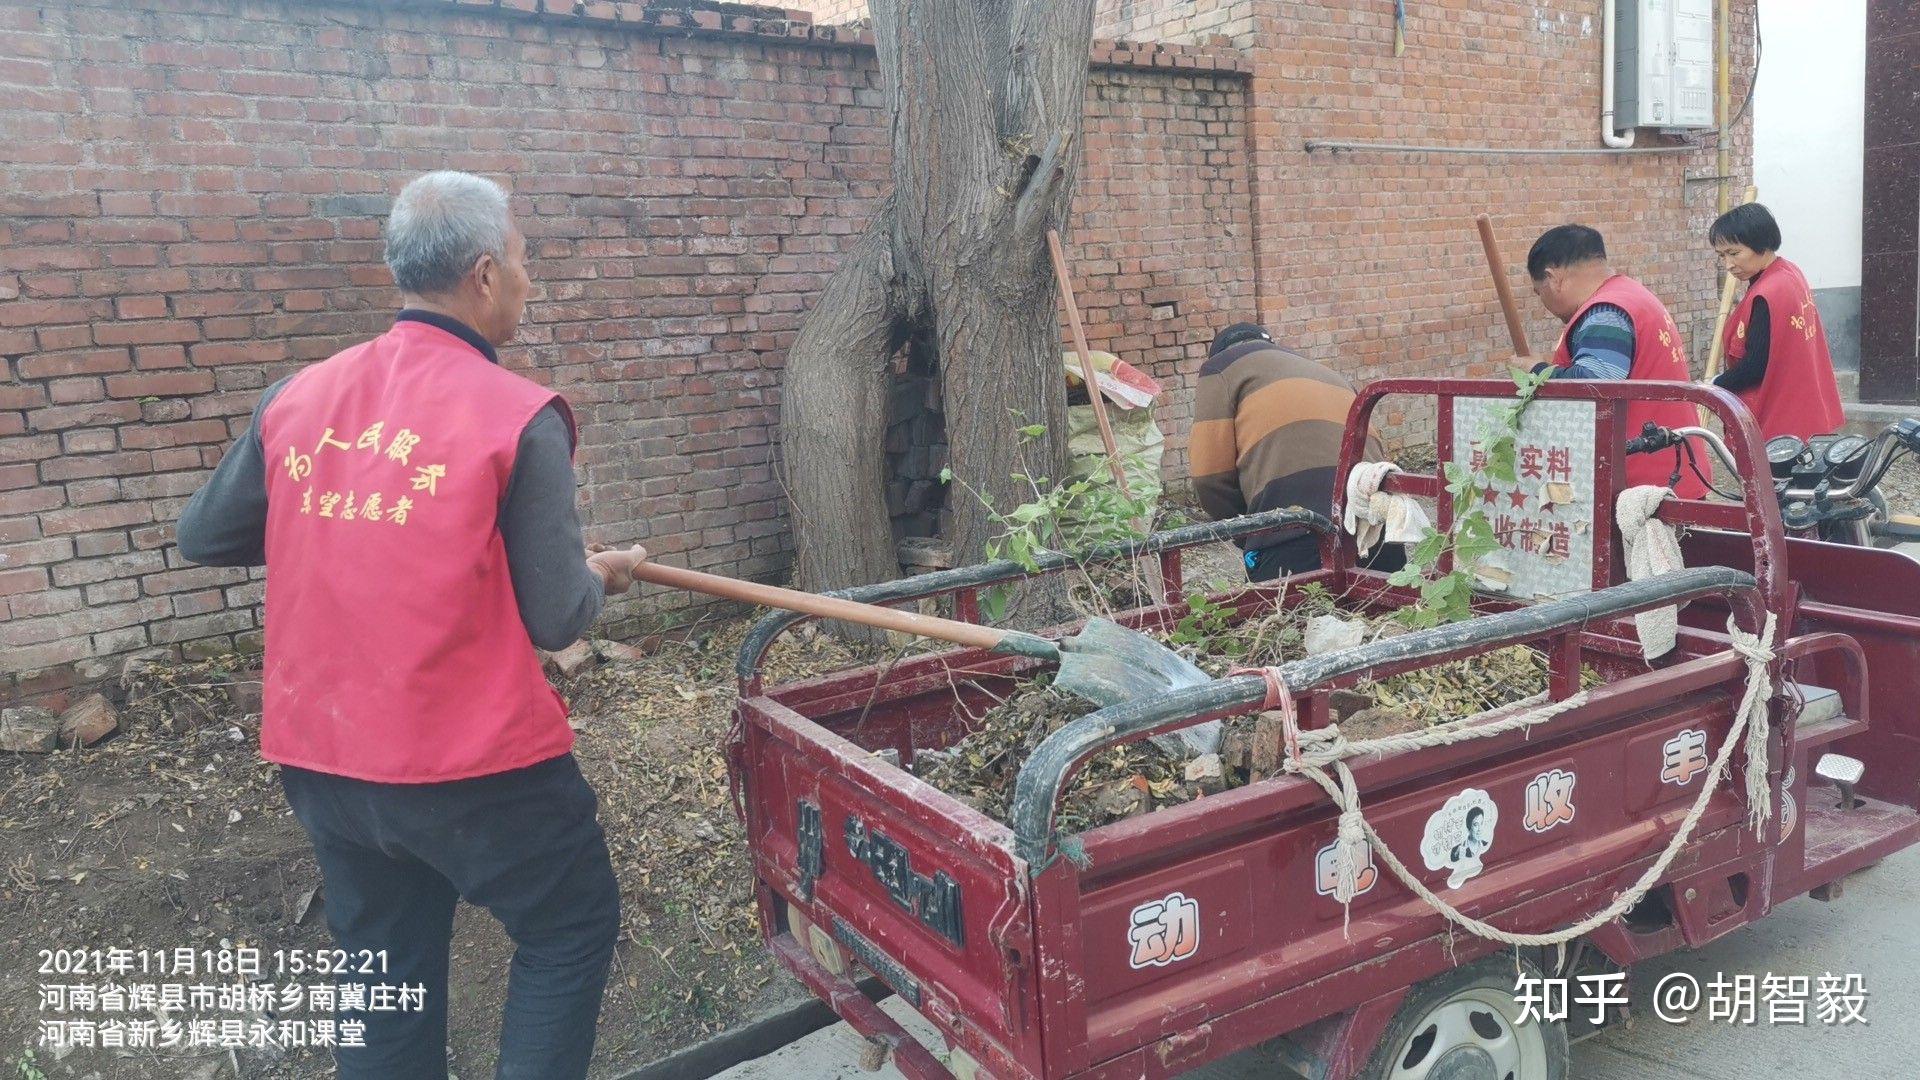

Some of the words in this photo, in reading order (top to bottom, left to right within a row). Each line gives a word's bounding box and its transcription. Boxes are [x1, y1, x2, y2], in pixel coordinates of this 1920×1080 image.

[1661, 729, 1708, 785] 丰
[1523, 769, 1575, 832] 收
[1127, 892, 1200, 969] 动
